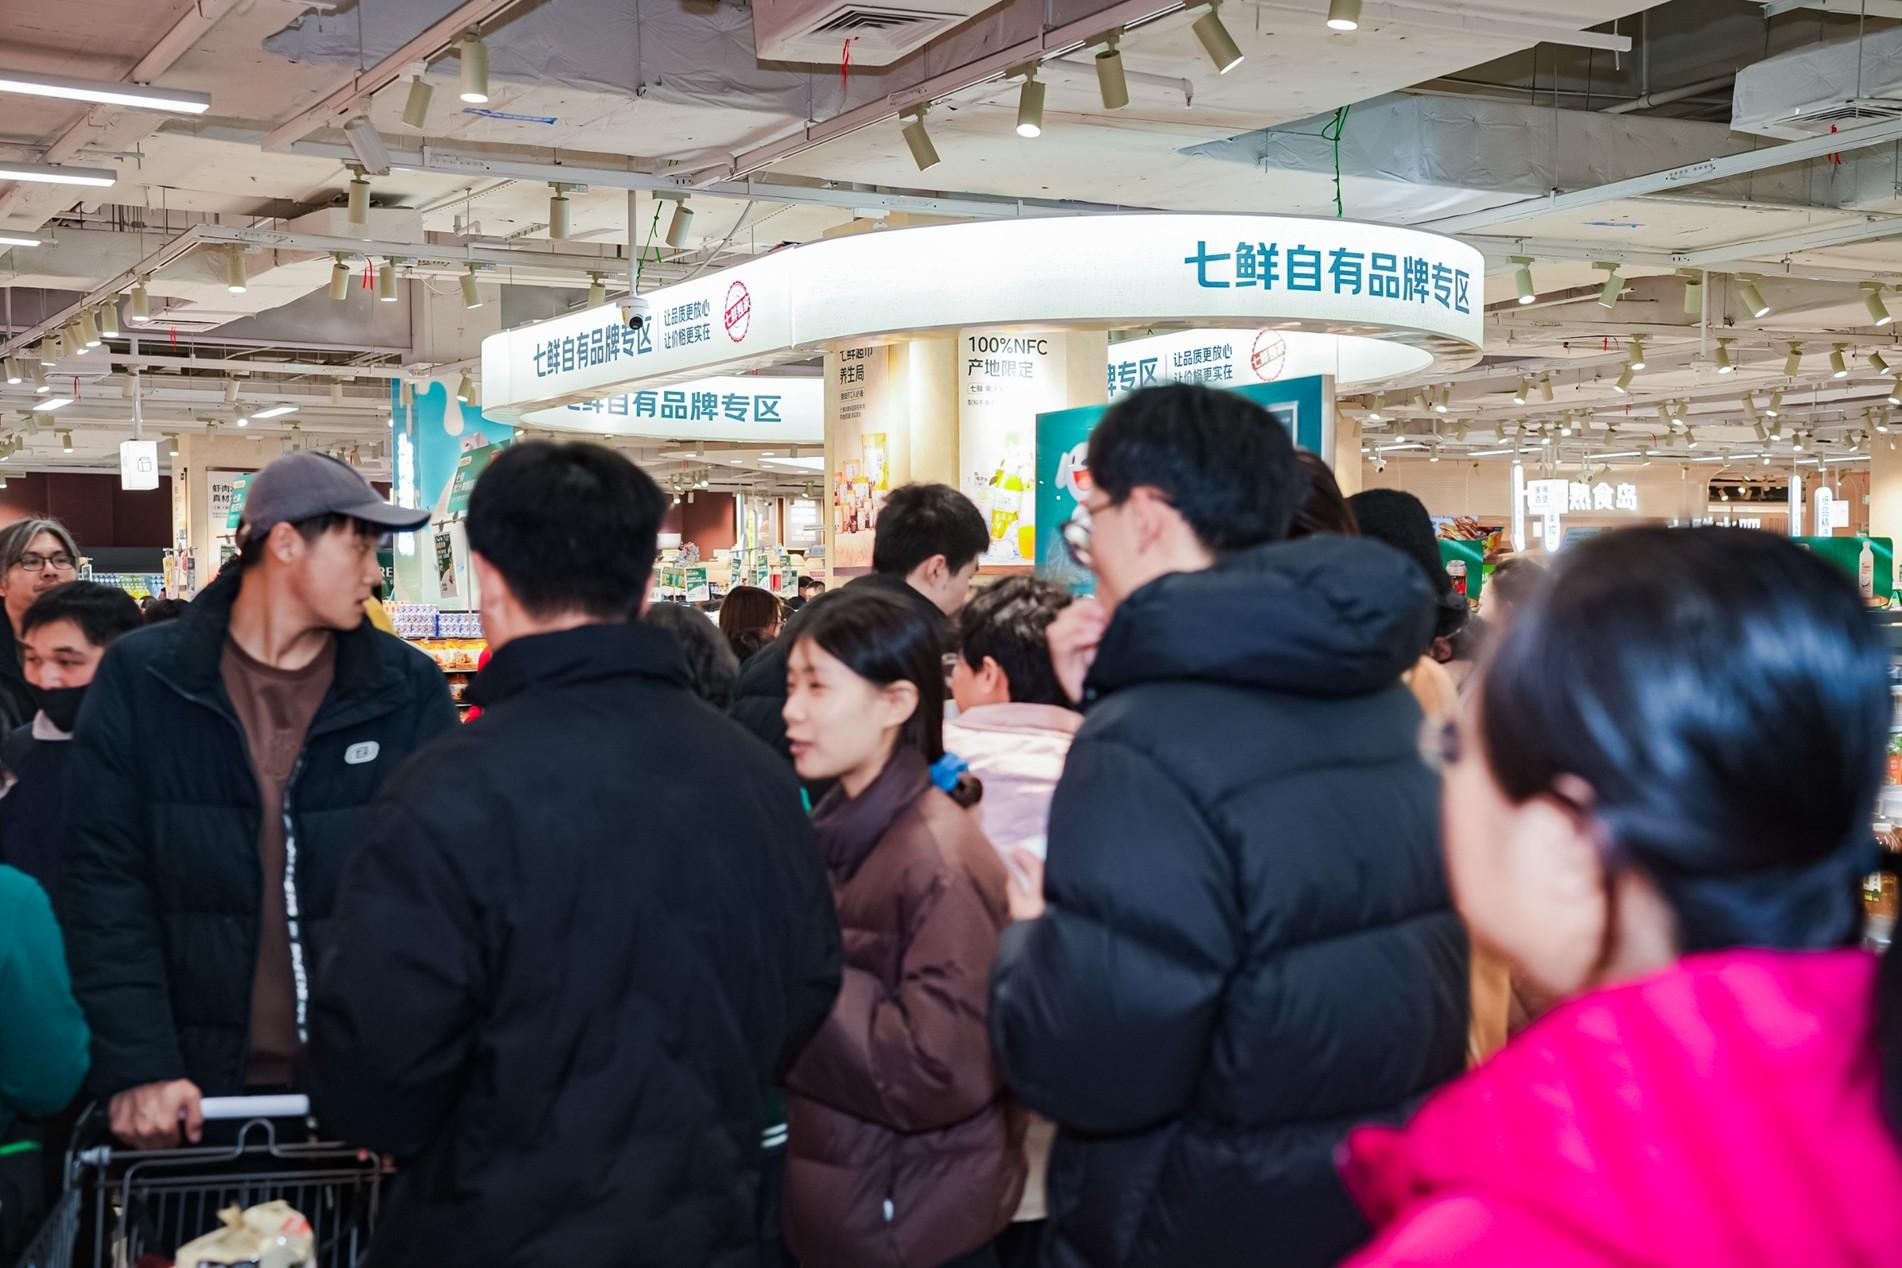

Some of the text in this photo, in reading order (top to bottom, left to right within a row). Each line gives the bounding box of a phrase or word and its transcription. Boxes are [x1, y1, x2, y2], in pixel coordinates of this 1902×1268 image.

[1184, 241, 1470, 315] 七鲜自有品牌专区
[664, 299, 710, 327] 让品质更放心
[533, 316, 652, 377] 七鲜自有品牌专区
[664, 323, 710, 349] 让价格更实在
[968, 336, 1047, 355] 100%NFC
[968, 358, 1033, 378] 产地限定
[1173, 343, 1233, 367] 让品质更放心
[840, 364, 864, 384] 养生局
[567, 390, 782, 423] 自有品牌专区
